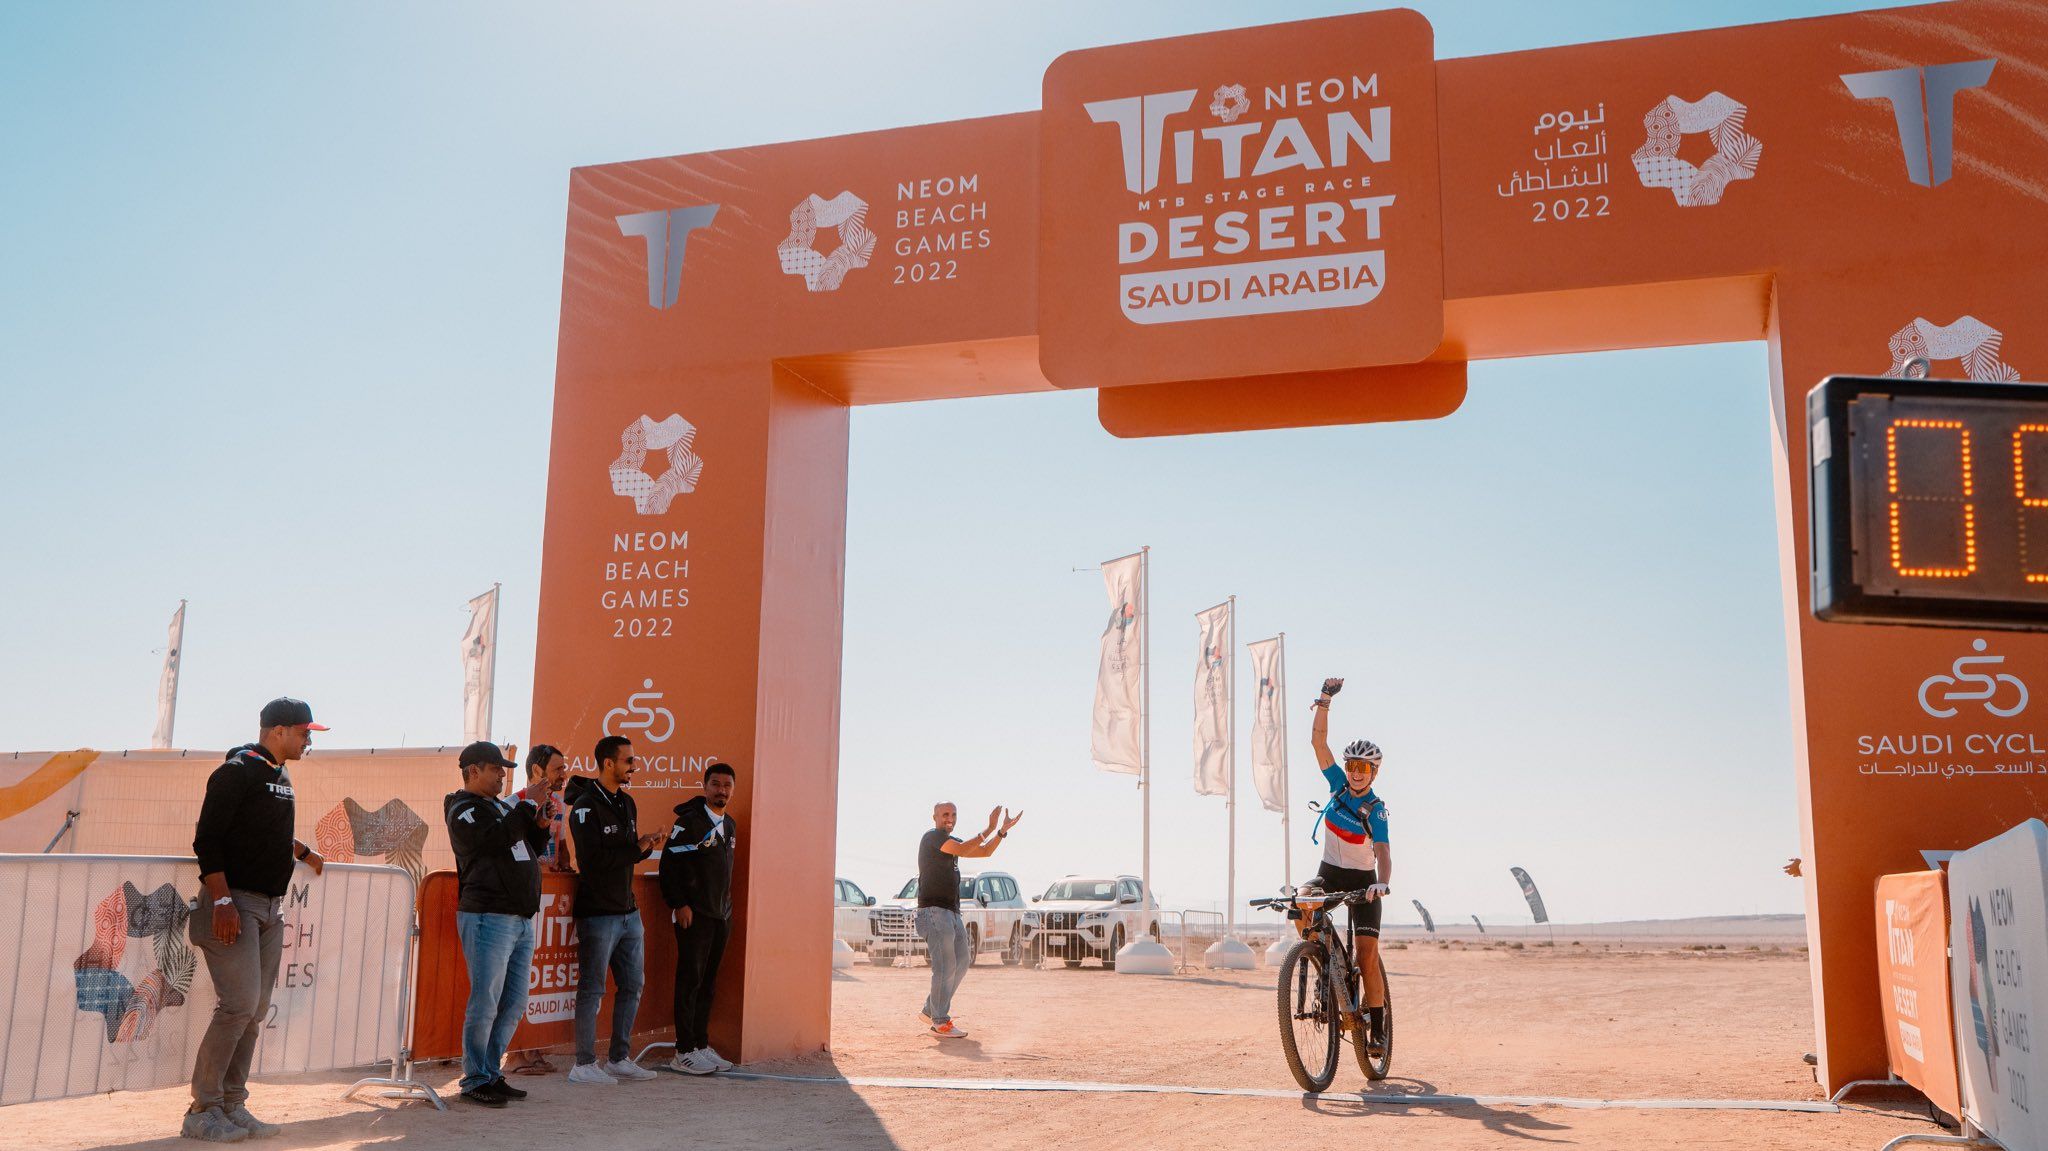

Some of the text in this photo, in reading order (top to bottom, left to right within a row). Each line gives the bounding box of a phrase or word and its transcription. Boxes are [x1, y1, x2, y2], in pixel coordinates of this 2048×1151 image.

[1264, 72, 1379, 111] NEOM
[1534, 102, 1605, 136] نيوم
[1082, 88, 1392, 195] TITAN
[1534, 129, 1607, 166] ألعاب
[897, 173, 979, 201] NEOM
[1138, 175, 1373, 212] MTB STAGE RACE
[1497, 161, 1609, 198] الشاطئ
[896, 201, 988, 229] BEACH
[1532, 195, 1610, 223] 2022
[894, 228, 992, 257] GAMES
[1118, 194, 1397, 265] DESERT
[892, 260, 959, 285] 2022
[1126, 264, 1379, 310] SAUDI ARABIA
[612, 530, 689, 553] NEOM
[605, 559, 689, 581] BEACH
[601, 588, 690, 610] GAMES
[612, 617, 673, 638] 2022
[1857, 733, 2047, 755] SAUDI CYCL
[563, 755, 598, 773] SAU
[1989, 887, 2016, 927] NEOM
[528, 962, 580, 990] DESE
[1994, 949, 2024, 989] BEACH
[528, 1000, 559, 1015] SAUDI
[2001, 1007, 2031, 1054] GAMES
